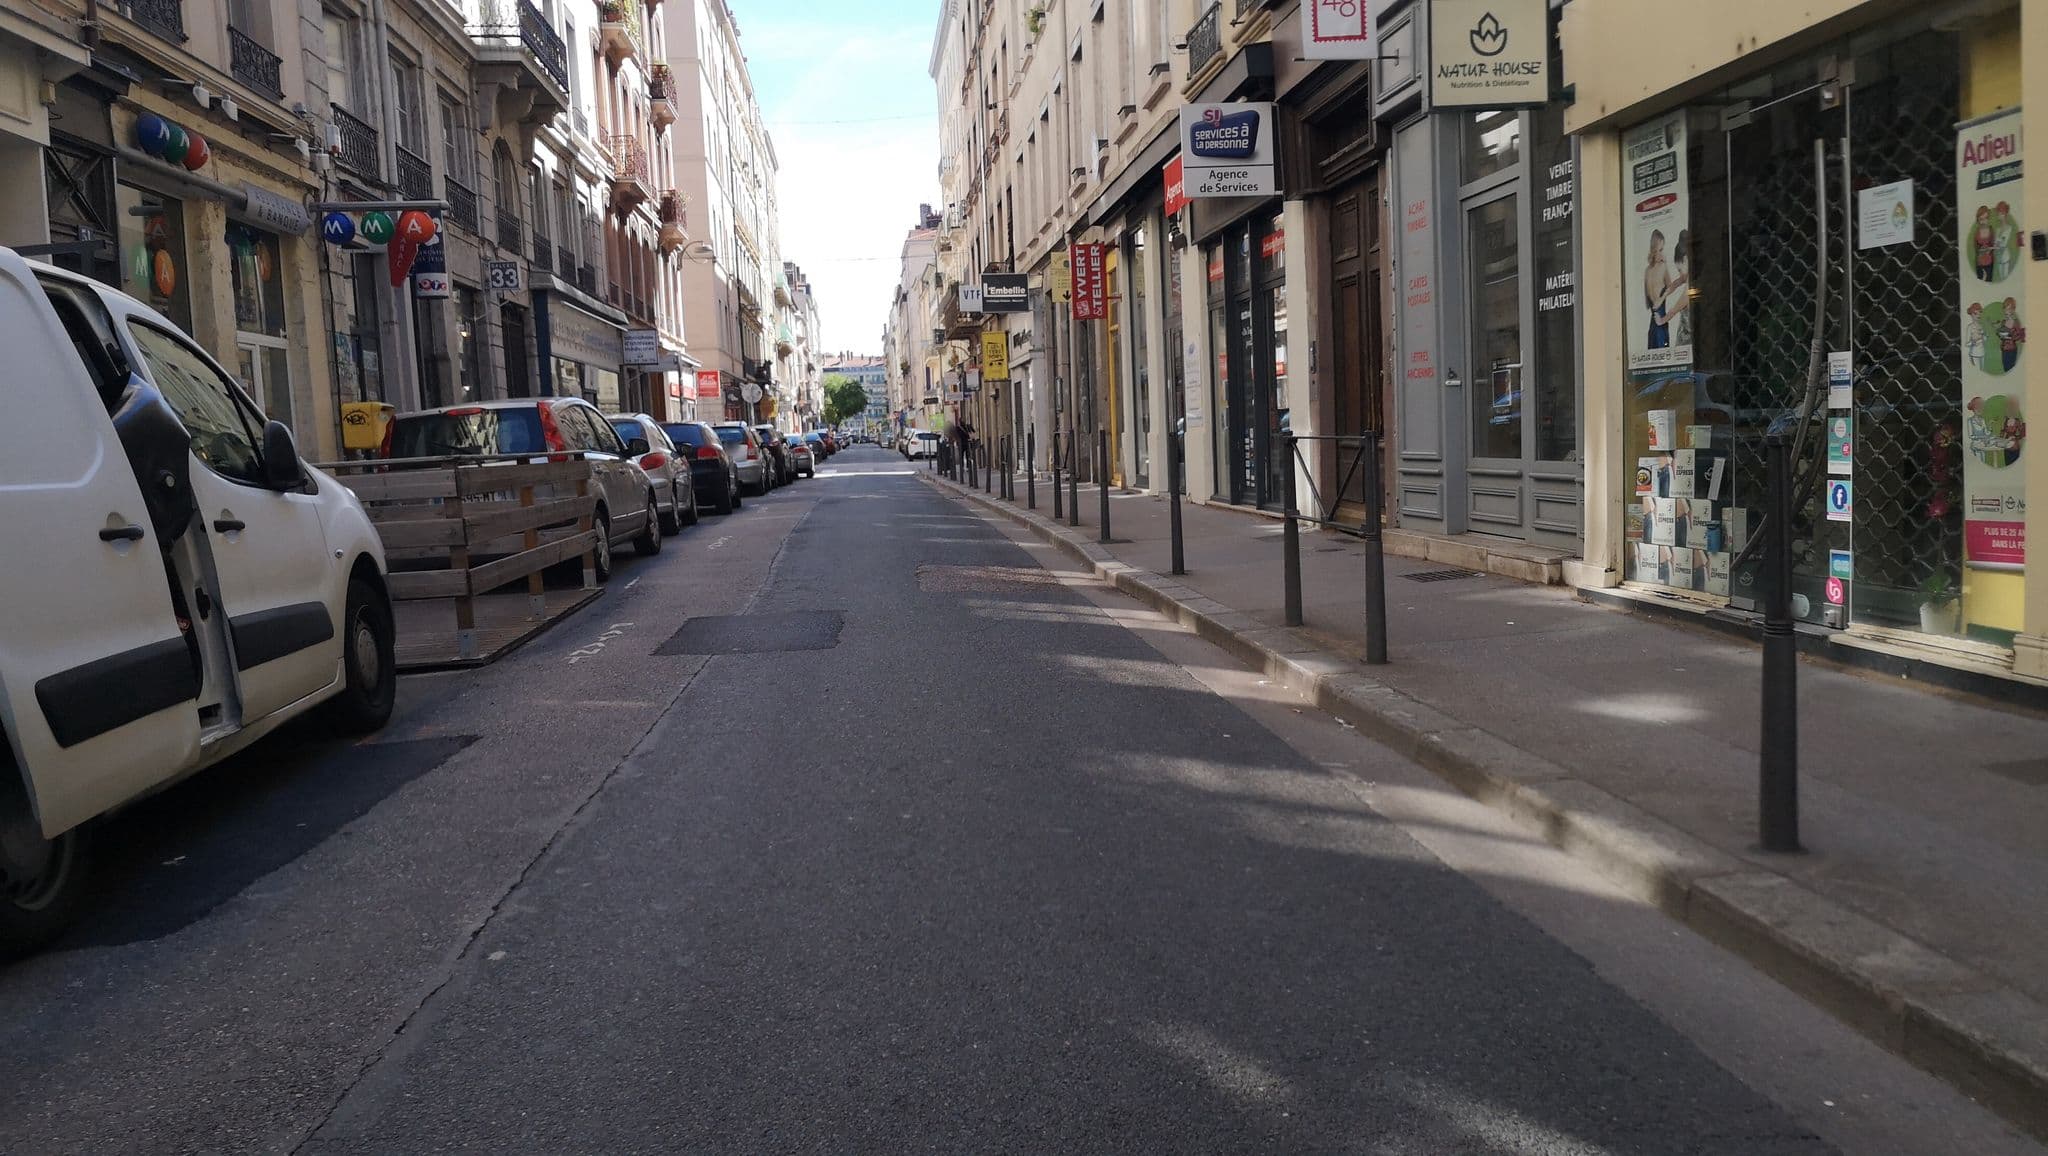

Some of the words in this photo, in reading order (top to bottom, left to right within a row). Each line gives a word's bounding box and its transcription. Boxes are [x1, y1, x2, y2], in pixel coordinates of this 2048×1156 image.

[1437, 64, 1488, 78] NATUR
[1492, 61, 1542, 76] HOUSE
[1450, 81, 1483, 89] Nutrition
[1241, 123, 1249, 137] à
[1962, 133, 2015, 168] Adieu
[1209, 170, 1248, 181] Agence
[1200, 183, 1212, 192] de
[1215, 182, 1258, 193] Services
[324, 220, 343, 234] M
[364, 219, 383, 233] M
[407, 218, 422, 234] A
[492, 268, 519, 288] 33
[1075, 246, 1087, 298] YVERT
[1545, 271, 1574, 290] MATÉRI
[983, 283, 1026, 298] L'Embellie
[1539, 294, 1574, 312] PHILATELI
